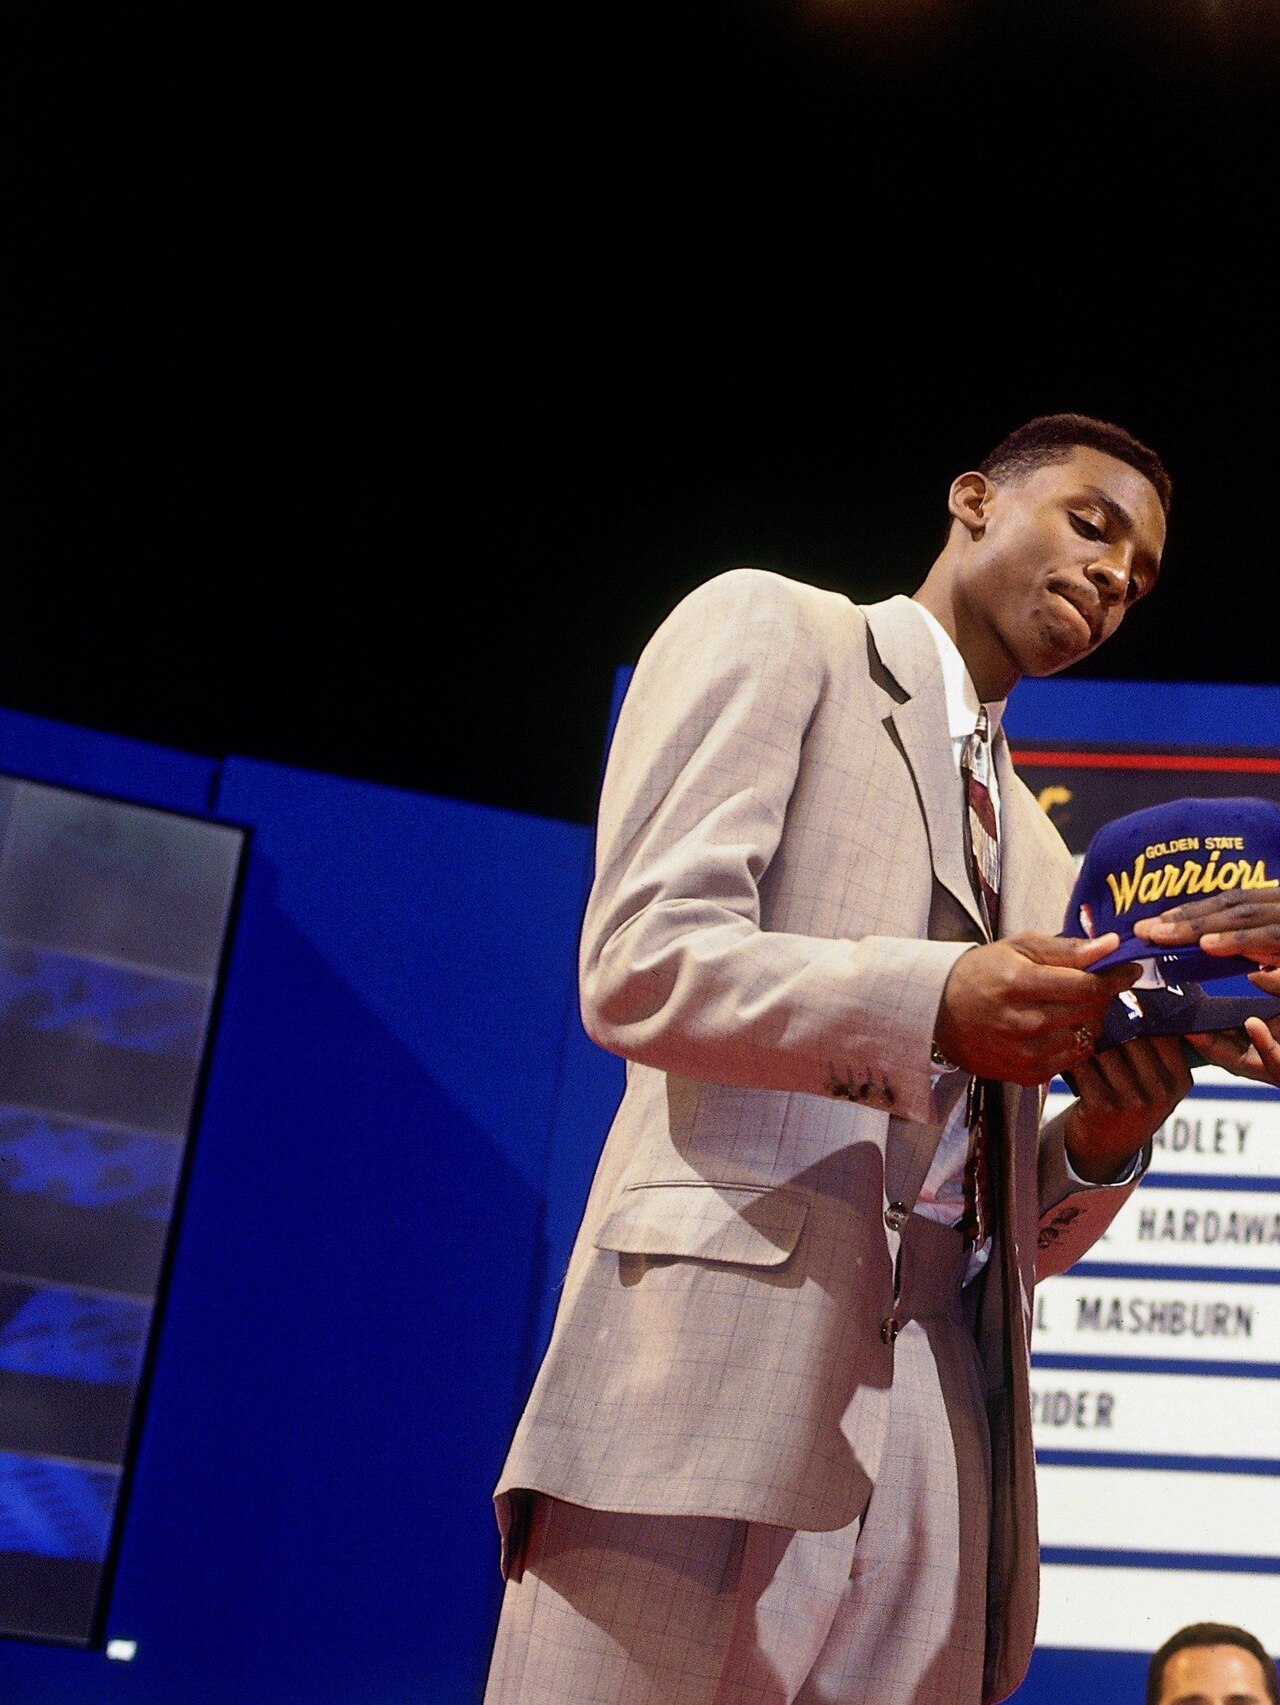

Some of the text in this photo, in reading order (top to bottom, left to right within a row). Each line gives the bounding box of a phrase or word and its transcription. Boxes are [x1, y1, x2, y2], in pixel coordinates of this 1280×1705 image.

[1145, 837, 1244, 859] GOLDEN STATE
[1106, 851, 1280, 916] Warriors
[1153, 1118, 1251, 1154] ADLEY
[1077, 1296, 1254, 1338] MASHBURN
